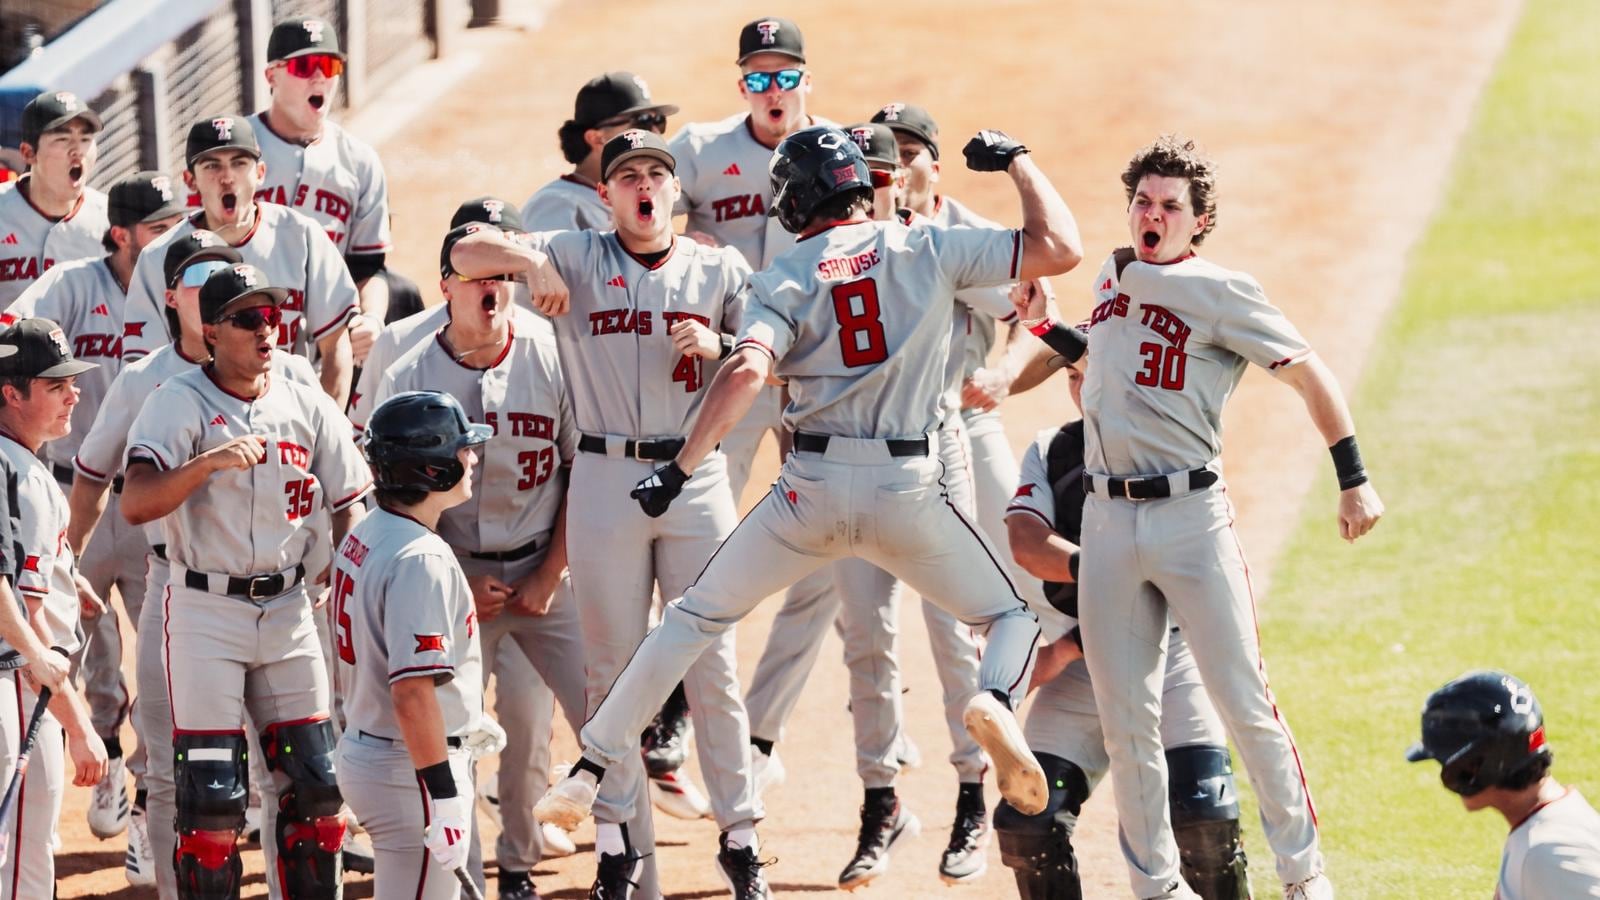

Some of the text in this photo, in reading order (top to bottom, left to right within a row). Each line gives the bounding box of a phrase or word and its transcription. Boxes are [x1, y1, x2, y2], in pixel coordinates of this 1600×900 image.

[712, 194, 765, 222] TEXA
[0, 257, 55, 280] EXA
[818, 249, 880, 279] SHOUSE
[589, 309, 653, 337] TEXAS
[831, 277, 888, 368] 8
[1090, 292, 1191, 351] EXAS TECH
[73, 333, 123, 359] TEXA
[1135, 342, 1187, 391] 30
[508, 411, 554, 440] TECH
[517, 446, 553, 490] 33
[284, 477, 314, 521] 35
